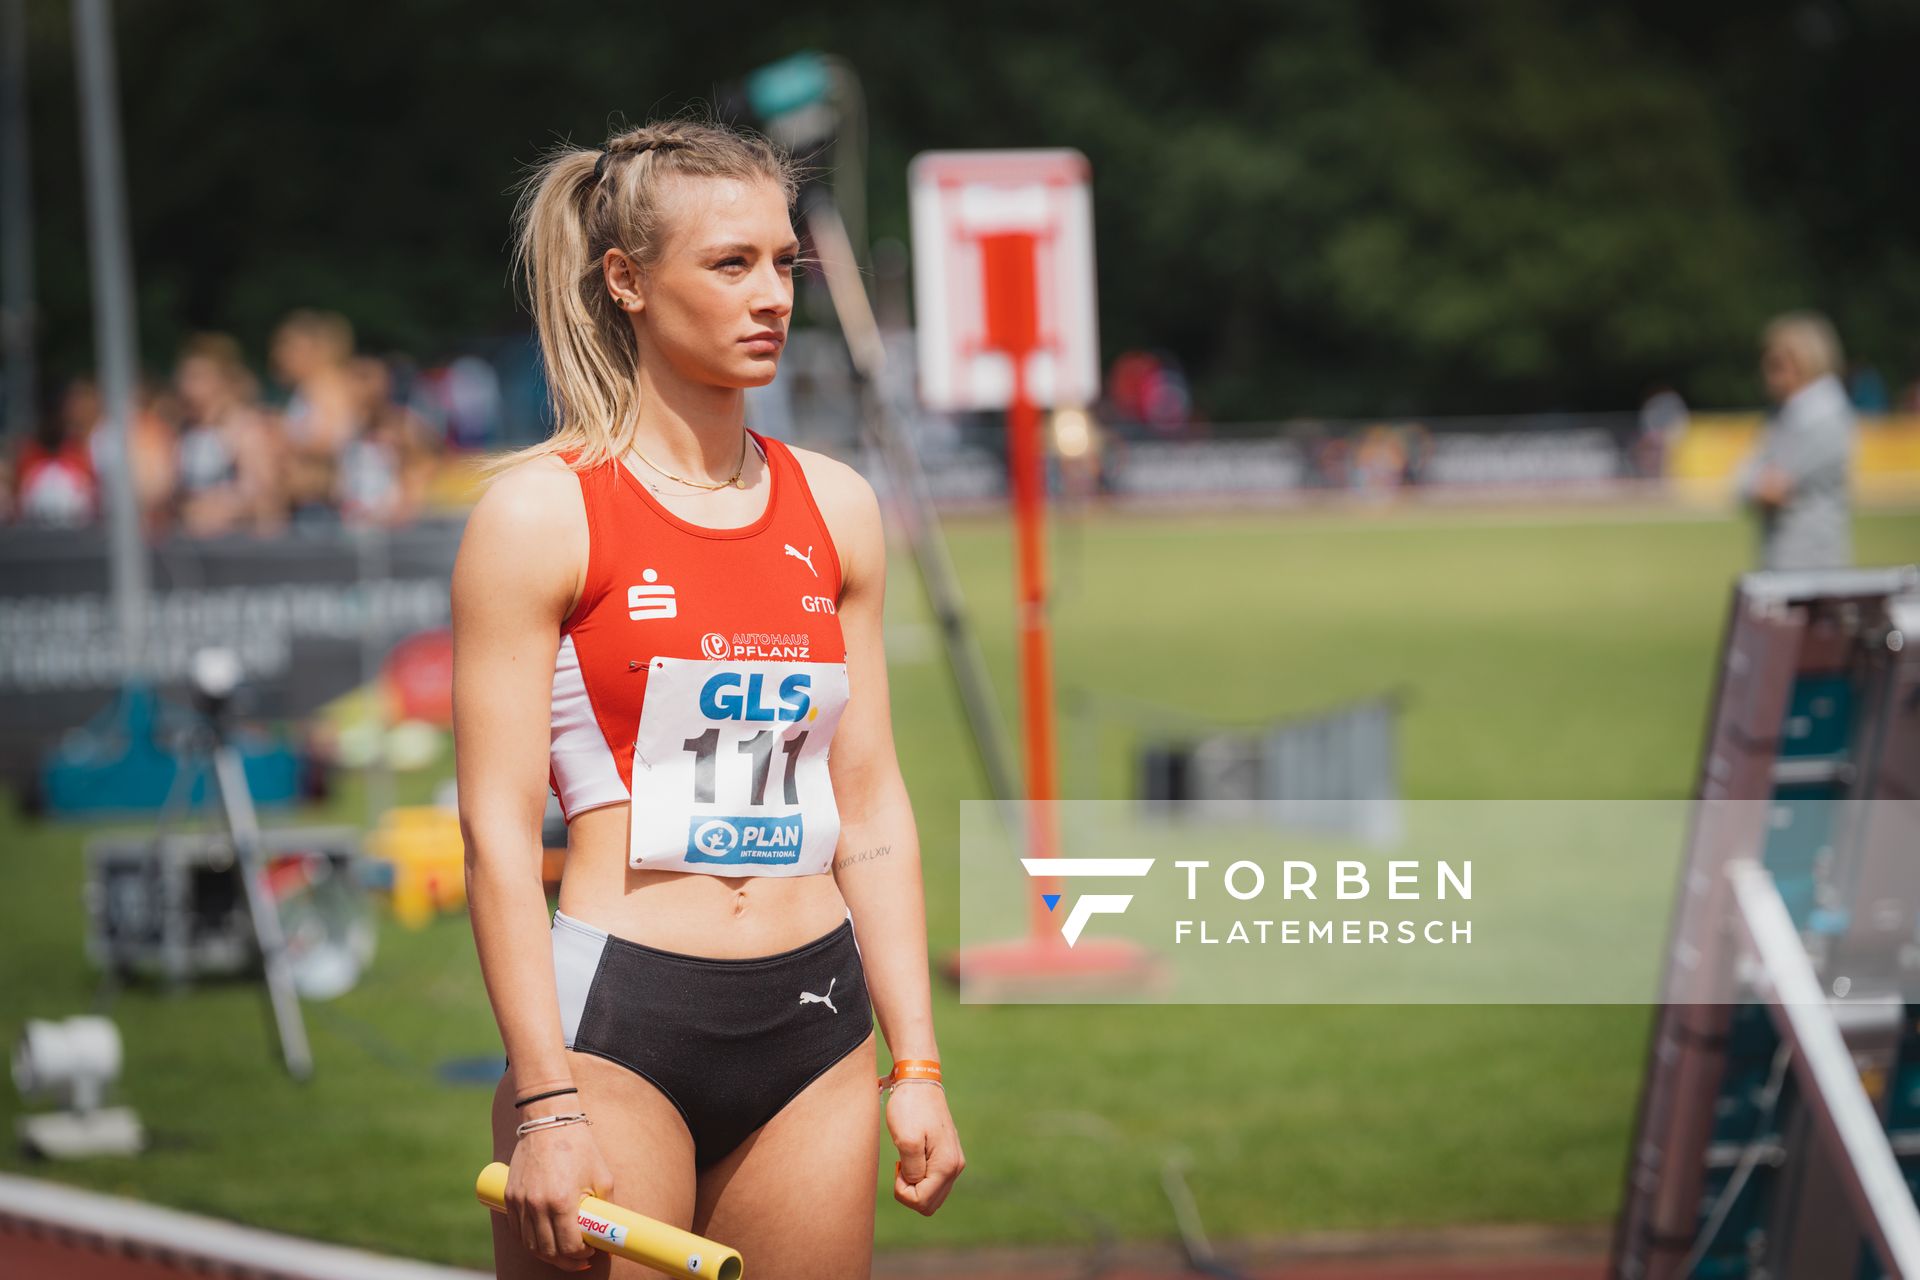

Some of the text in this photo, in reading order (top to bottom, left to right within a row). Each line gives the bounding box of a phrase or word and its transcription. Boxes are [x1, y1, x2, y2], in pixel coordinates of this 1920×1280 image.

[801, 595, 836, 615] GfTD
[732, 633, 810, 645] AUTOHAUS
[733, 645, 810, 658] PFLANZ
[683, 728, 809, 805] 111
[742, 825, 799, 847] PLAN
[740, 849, 797, 858] INTERNATIONAL
[869, 846, 891, 860] LXIV
